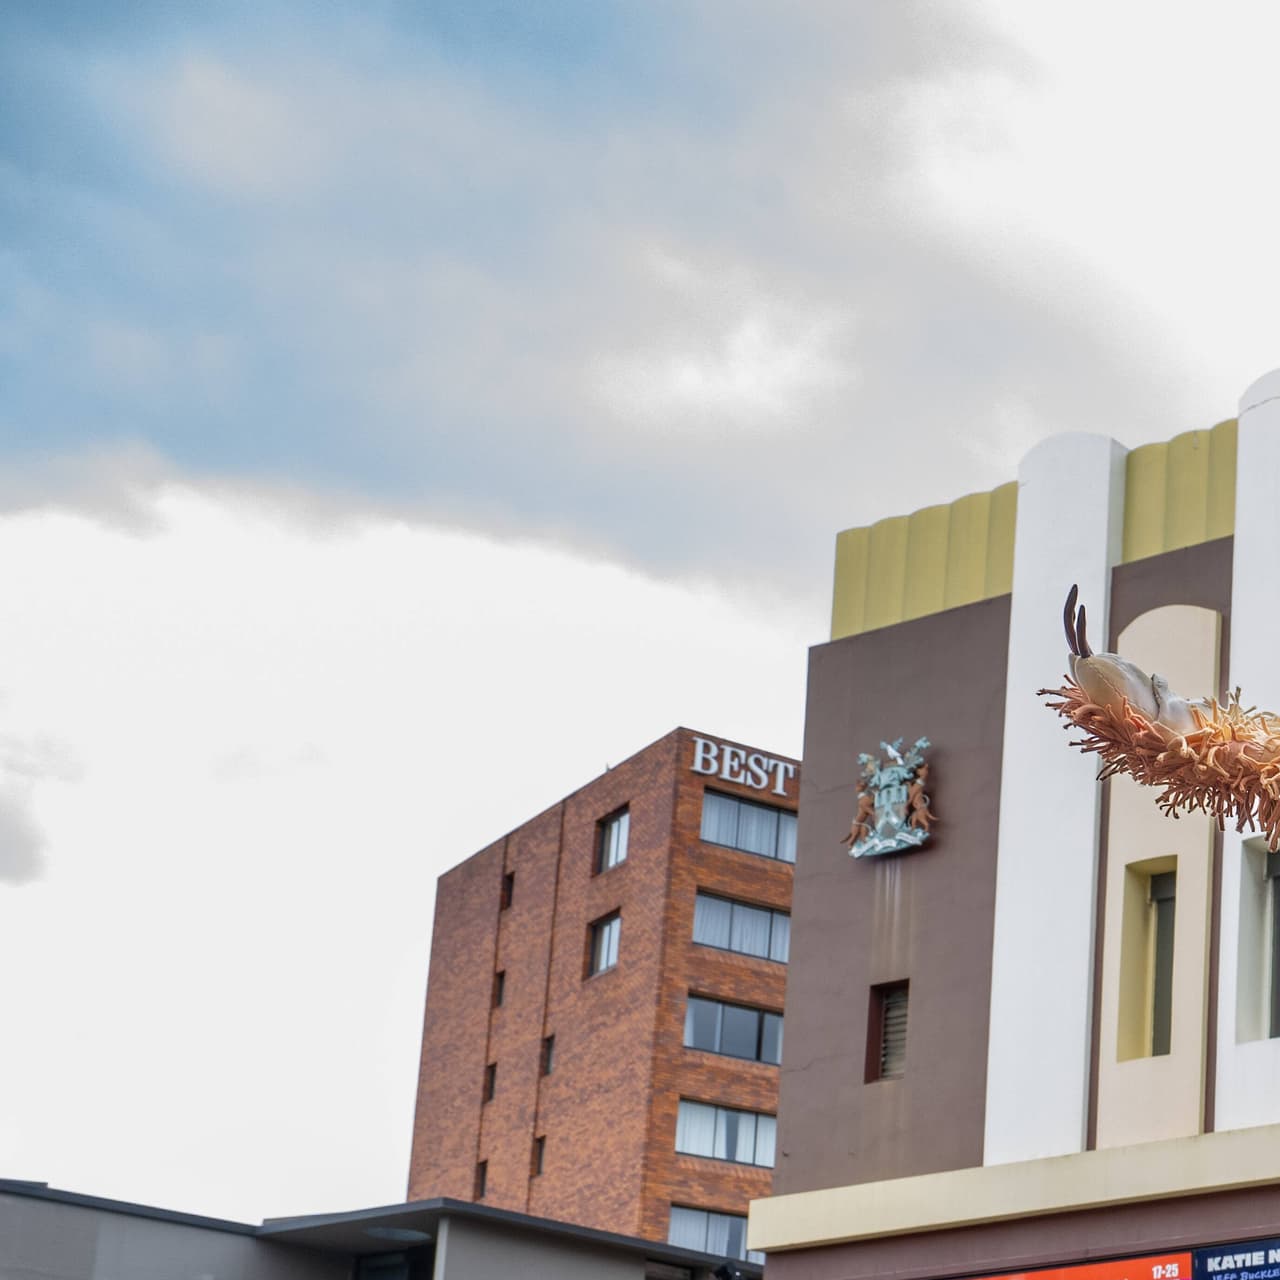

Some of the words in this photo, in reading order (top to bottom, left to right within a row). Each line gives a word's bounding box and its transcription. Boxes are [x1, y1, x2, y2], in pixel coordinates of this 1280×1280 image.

[690, 736, 798, 797] BEST
[1152, 1263, 1179, 1279] 17-25
[1207, 1251, 1264, 1272] KATIE
